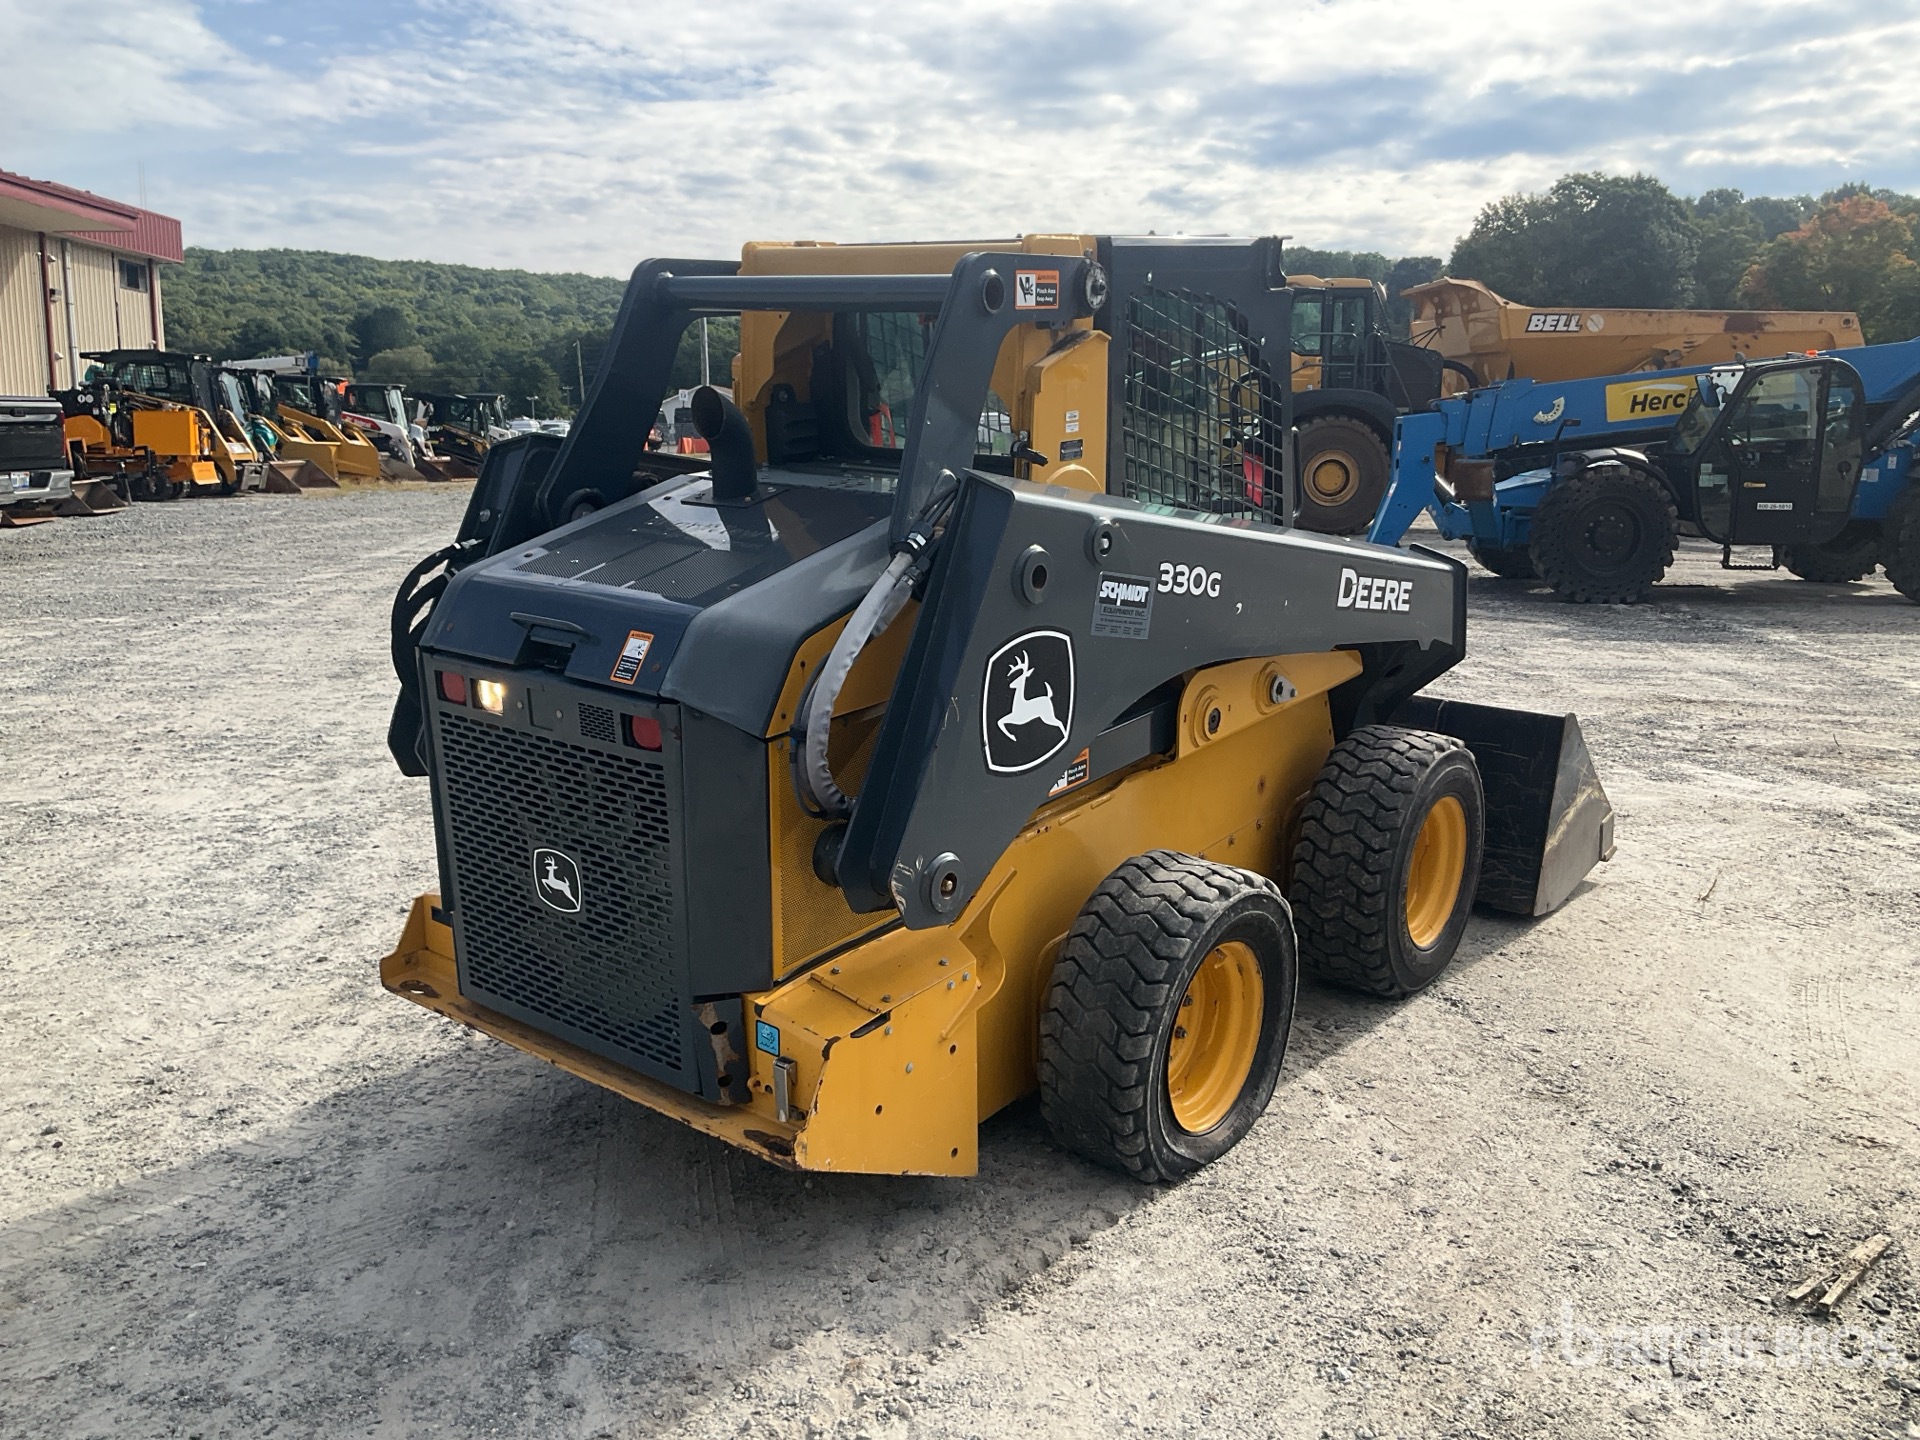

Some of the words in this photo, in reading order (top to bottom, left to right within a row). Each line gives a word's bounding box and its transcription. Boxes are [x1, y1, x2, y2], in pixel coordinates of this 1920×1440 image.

[1526, 314, 1582, 332] BELL
[1099, 580, 1149, 607] SCHMIDT
[1157, 562, 1222, 598] 330G
[1337, 567, 1413, 612] DEERE
[1102, 606, 1134, 616] EQUIPMENT
